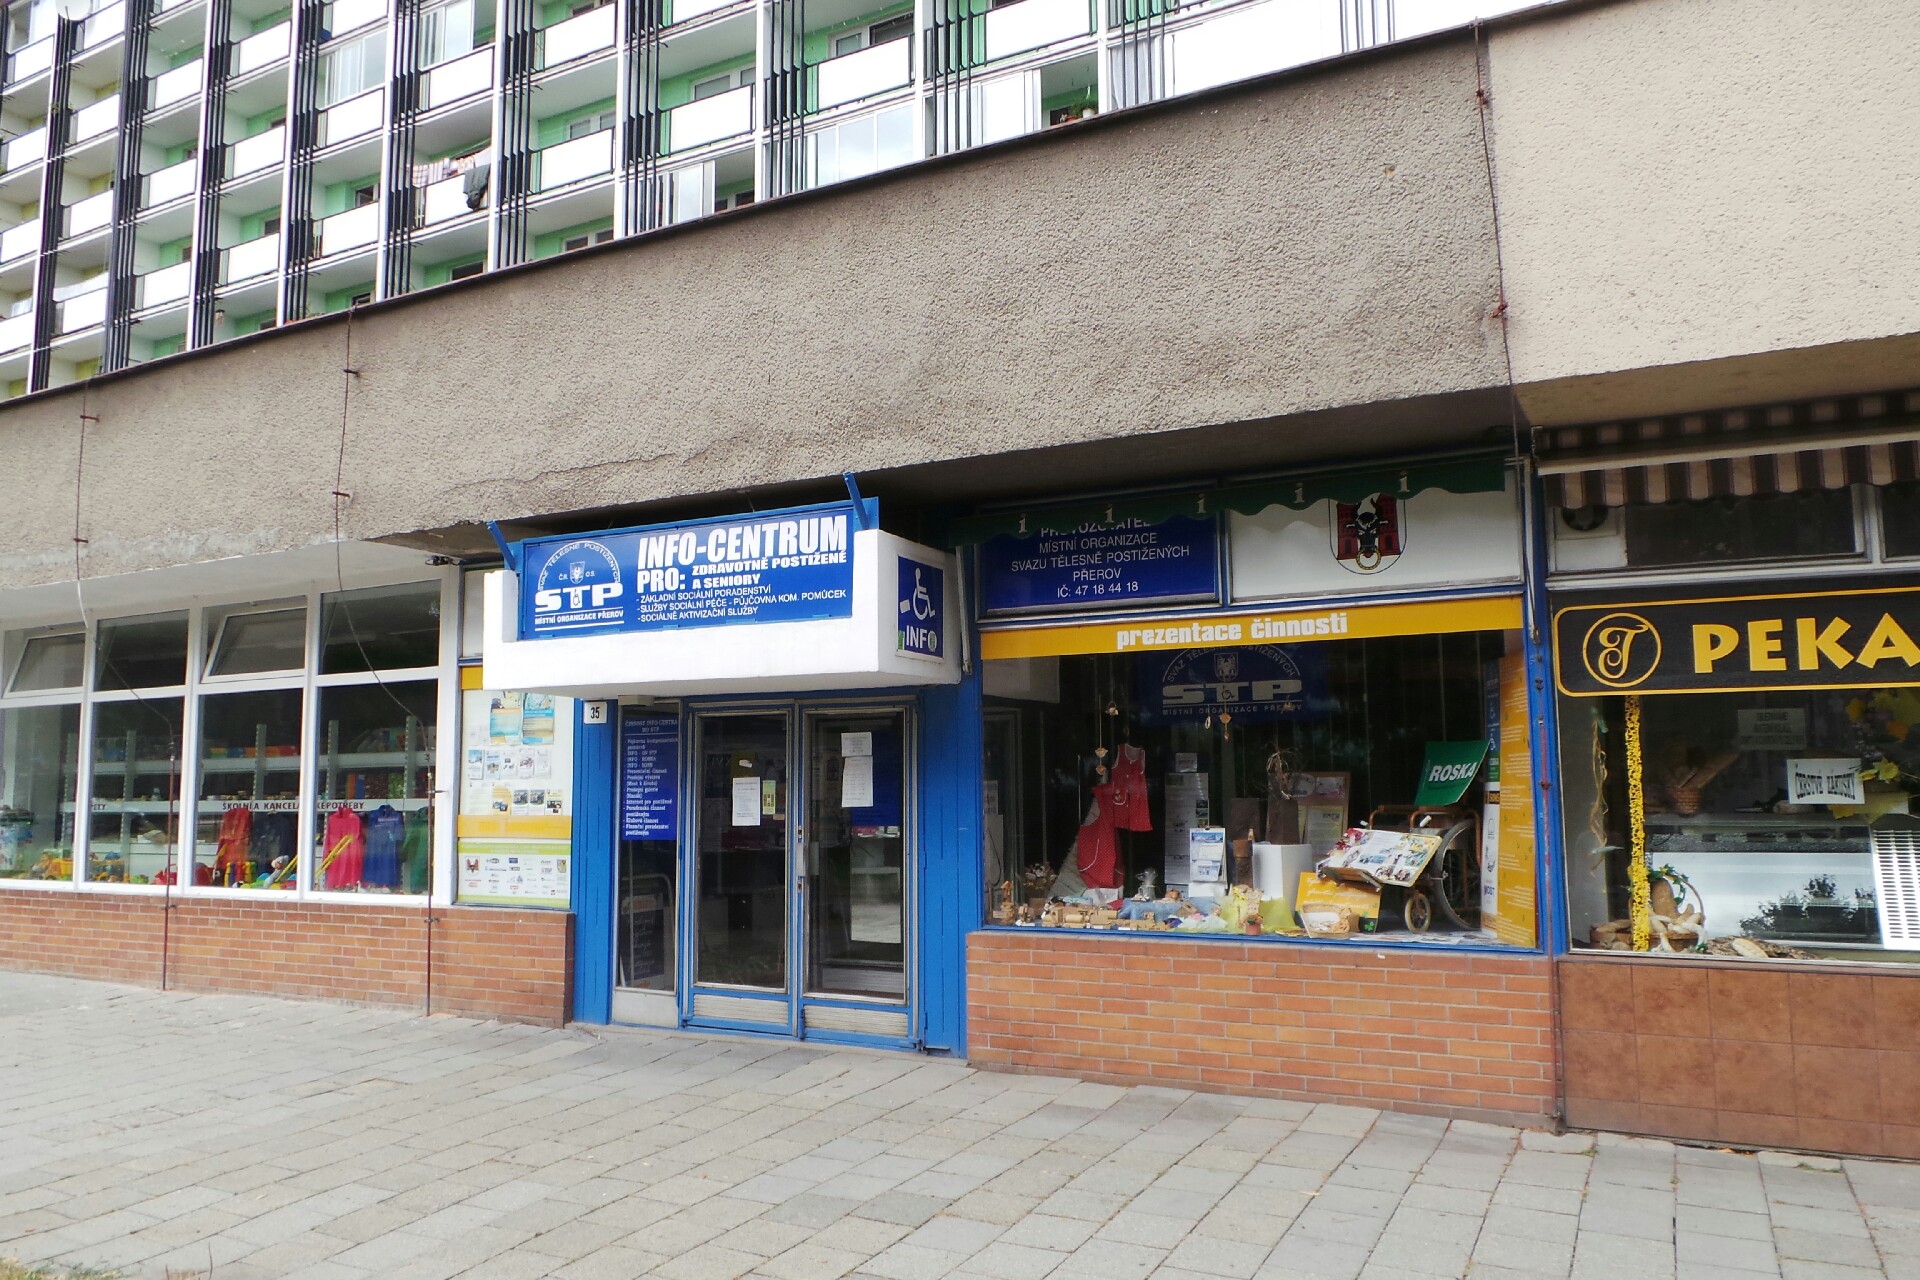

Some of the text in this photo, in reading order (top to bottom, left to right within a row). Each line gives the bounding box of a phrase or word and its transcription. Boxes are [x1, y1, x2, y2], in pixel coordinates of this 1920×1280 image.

[637, 515, 847, 570] INFO-CENTRUM
[1039, 533, 1158, 553] MÍSTNÍ ORGANIZACE
[1011, 544, 1190, 572] SVAZU TĚLESNĚ POSTIŽENÝCH
[636, 549, 847, 593] PRO: ZDRAVOTNĚ POSTIŽENÉ
[692, 573, 761, 589] A SENIORY
[1073, 567, 1122, 581] PŘEROV
[535, 582, 623, 613] STP
[640, 591, 676, 604] ZÁKLADNÍ
[678, 588, 713, 600] SOCIÁLNÍ
[714, 584, 771, 597] PORADENSTVÍ
[669, 599, 704, 610] SOCIÁLNÍ
[705, 598, 727, 608] PÉČE
[733, 594, 777, 605] PŮJČOVNA
[778, 592, 800, 603] KOM.
[801, 588, 847, 601] POMŮCEK
[1057, 581, 1139, 598] IČ: 47 18 44 18
[557, 612, 597, 623] ORGANIZACE
[597, 609, 624, 618] PŘEROV
[679, 607, 726, 619] AKTIVIZAČNÍ
[727, 605, 759, 616] SLUŽBY
[906, 624, 938, 653] INFO
[1117, 612, 1348, 650] prezentace činnosti
[1162, 679, 1303, 704] STP
[591, 706, 600, 719] 35
[1428, 761, 1479, 782] ROSKA
